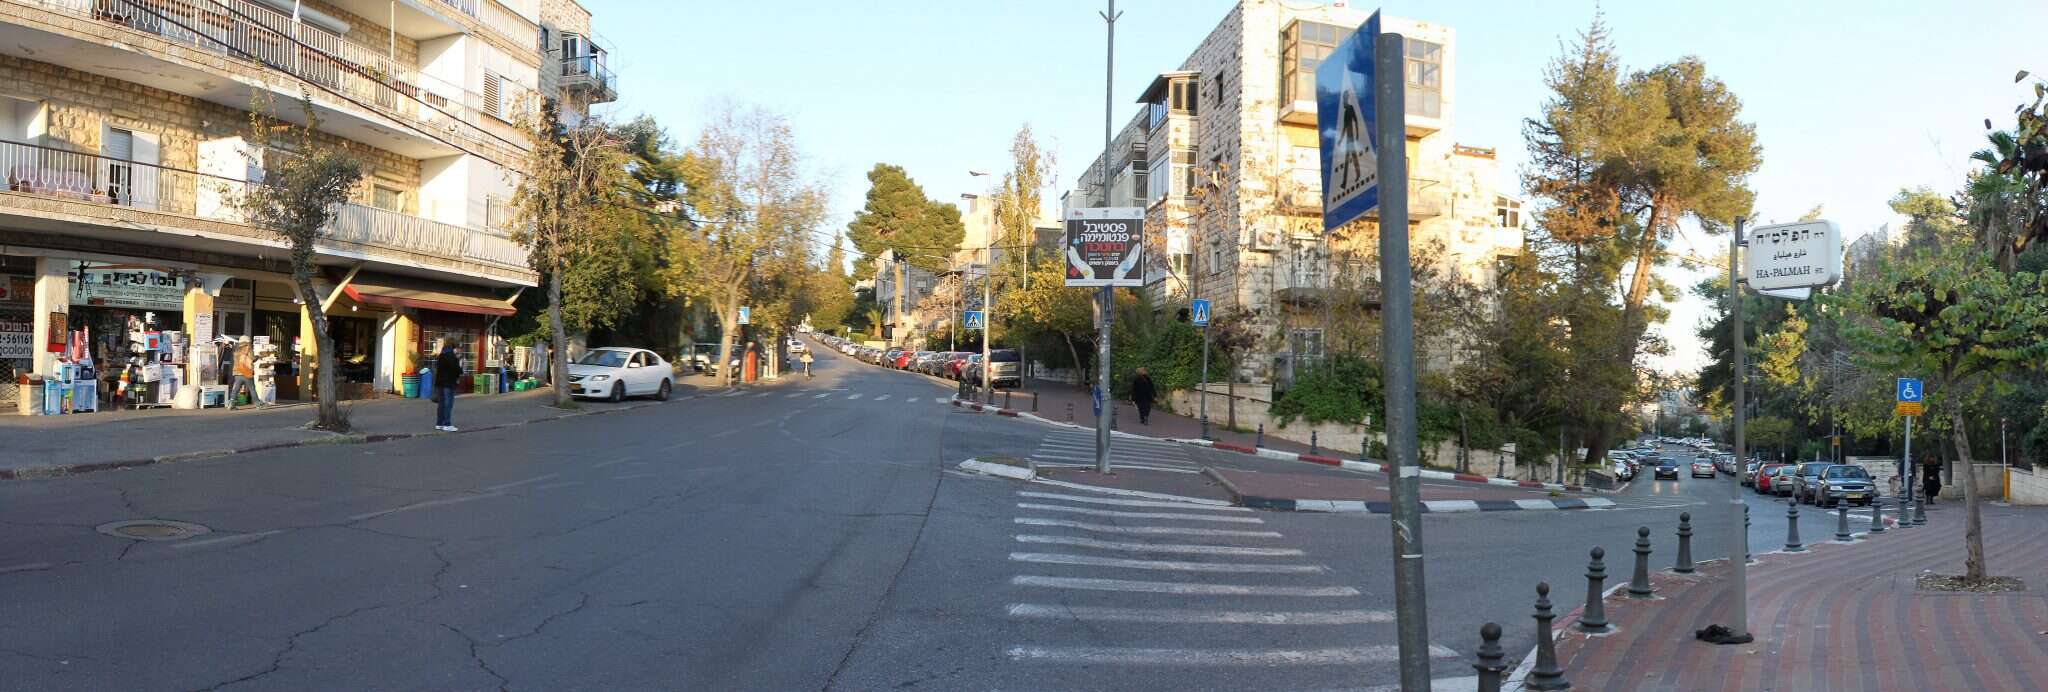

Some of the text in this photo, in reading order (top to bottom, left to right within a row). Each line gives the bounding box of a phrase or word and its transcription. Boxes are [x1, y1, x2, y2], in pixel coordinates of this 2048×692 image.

[1083, 221, 1127, 233] פסטיבל
[1080, 233, 1129, 242] פנטומימה
[1756, 265, 1810, 279] HA-PALMAH
